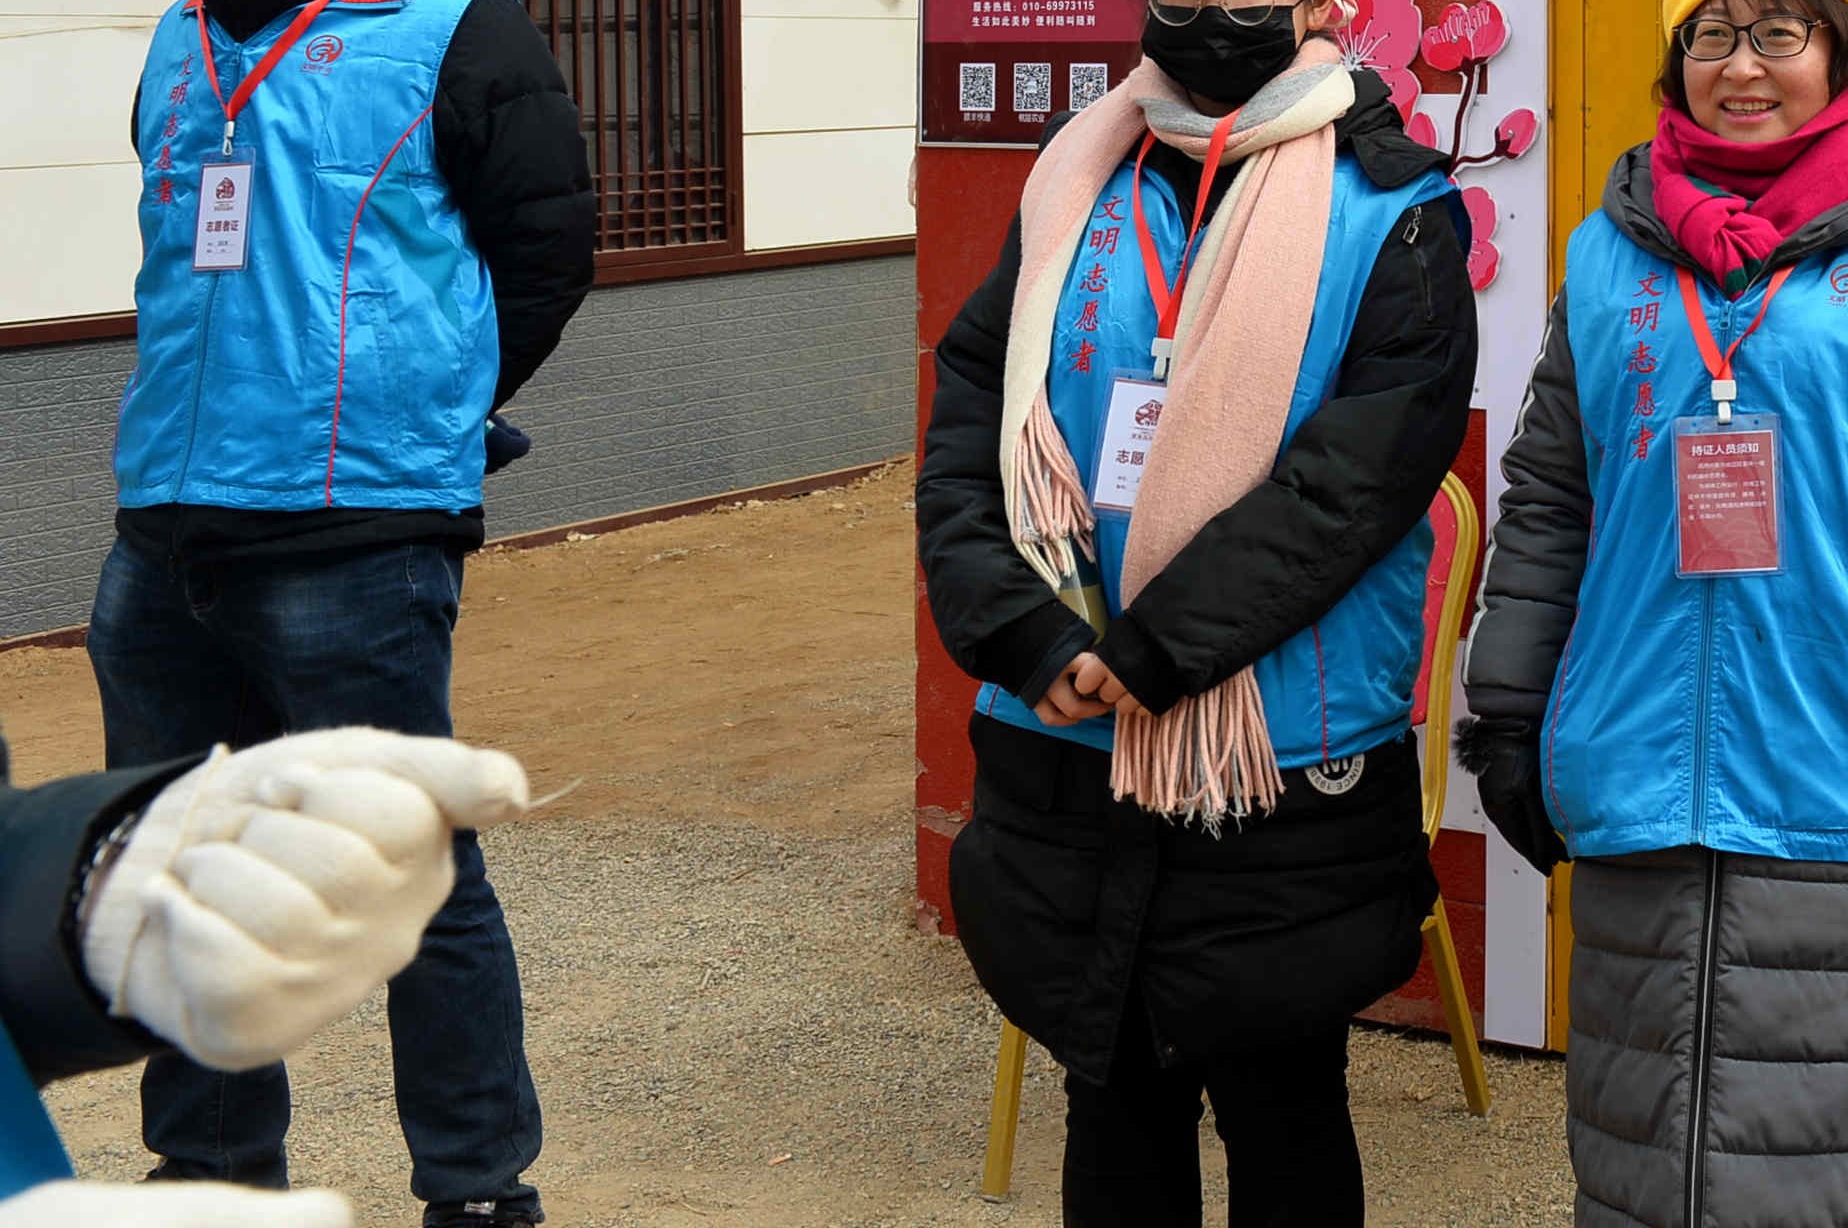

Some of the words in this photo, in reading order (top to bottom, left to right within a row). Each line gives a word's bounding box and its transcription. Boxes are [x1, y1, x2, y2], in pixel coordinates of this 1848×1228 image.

[1070, 194, 1126, 374] 文明志愿者
[1627, 270, 1666, 461] 文明志愿者
[1690, 441, 1761, 458] 持证人员须知
